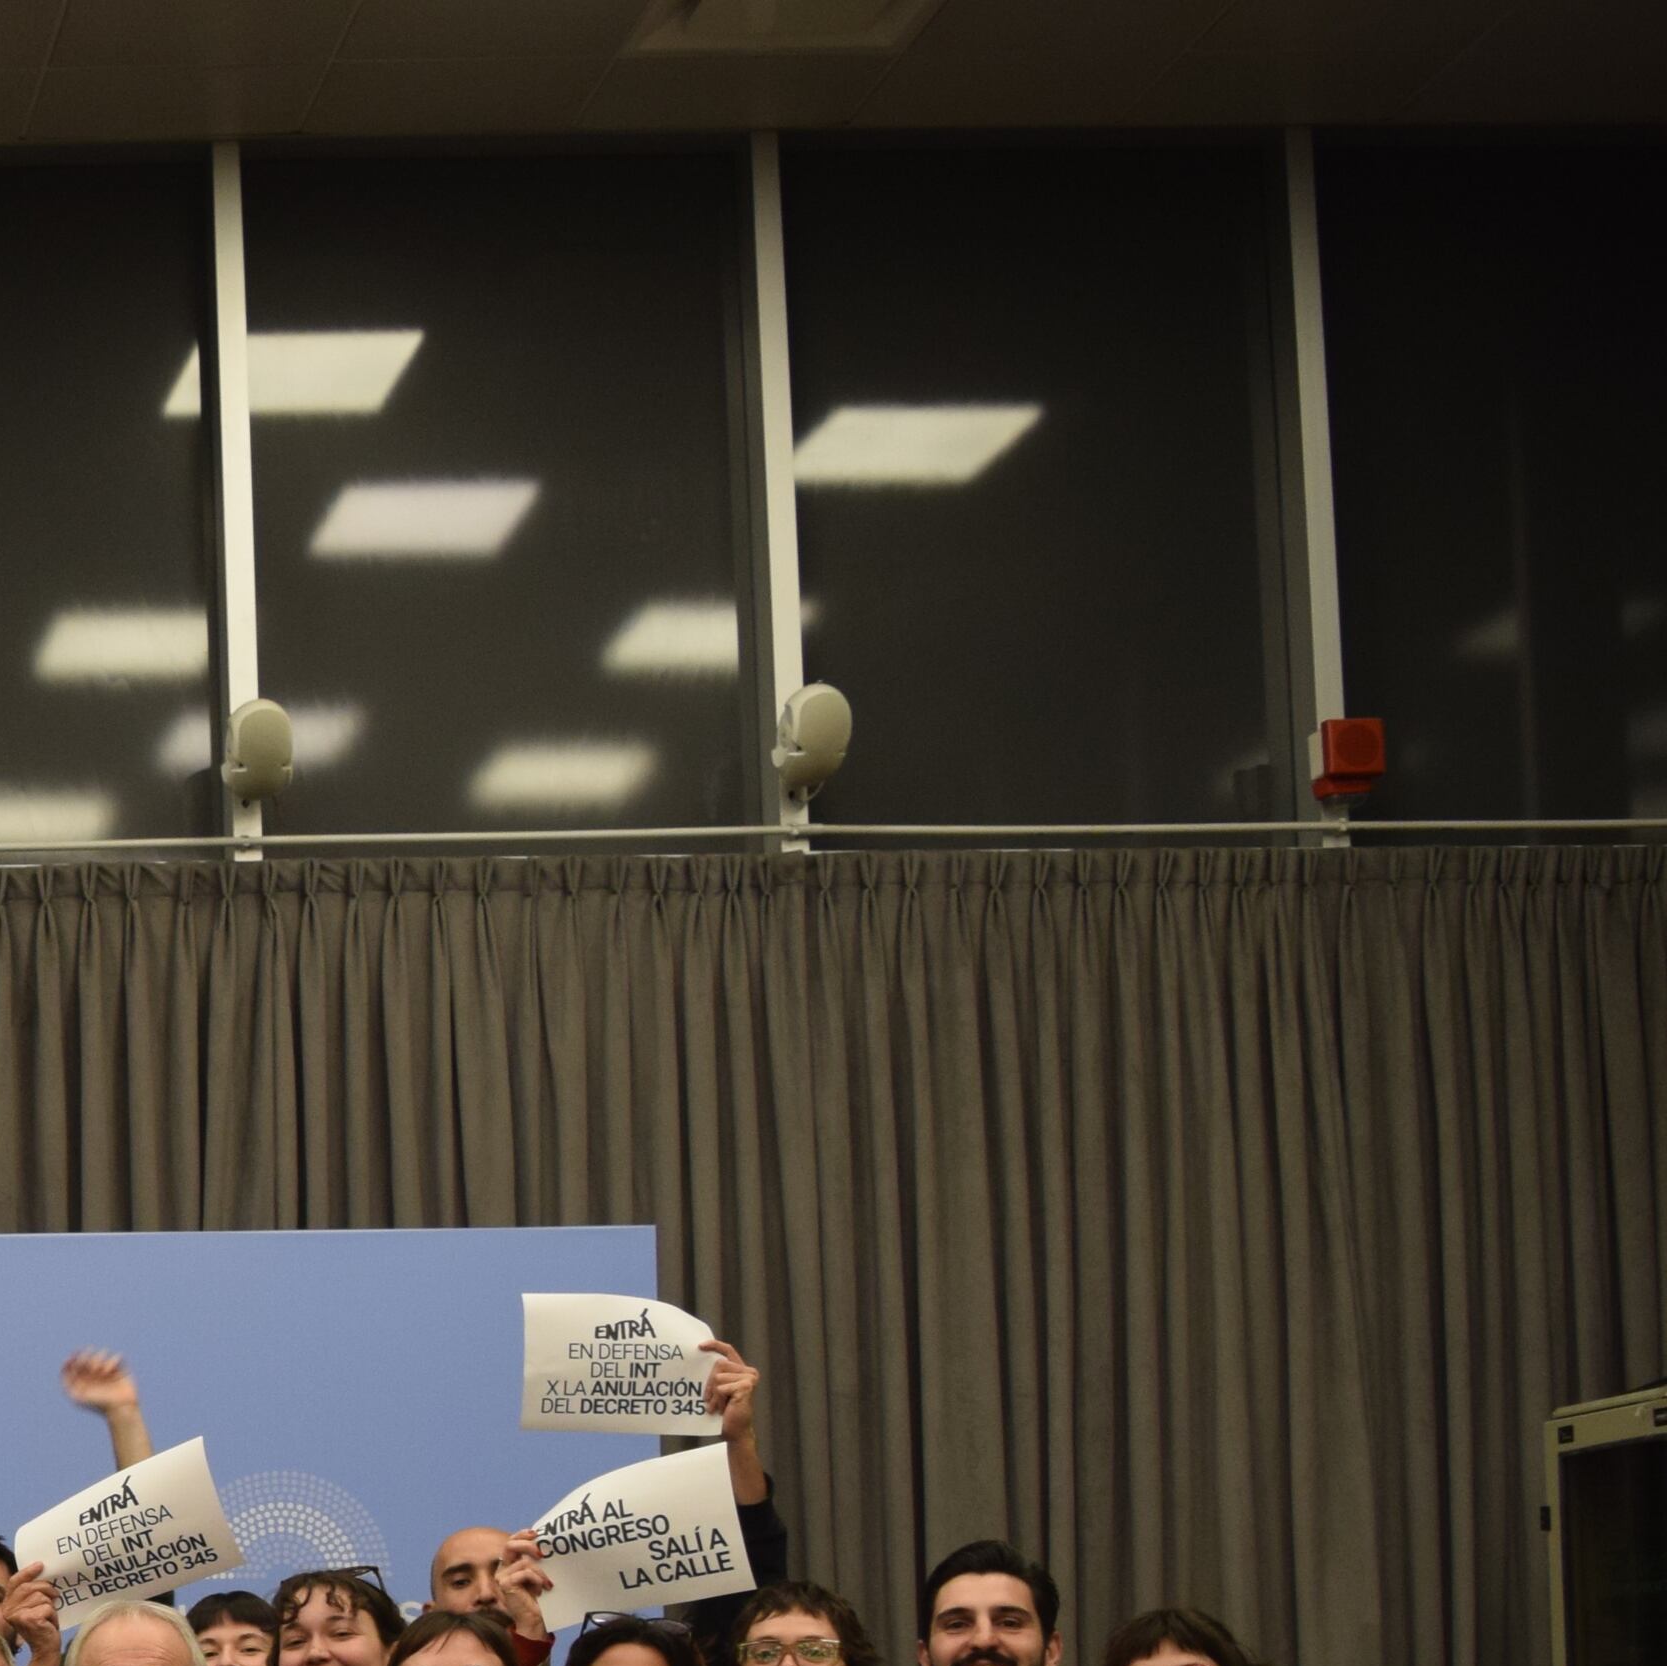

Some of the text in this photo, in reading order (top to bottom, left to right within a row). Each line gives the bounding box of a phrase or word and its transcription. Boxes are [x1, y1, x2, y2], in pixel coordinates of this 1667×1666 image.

[595, 1308, 656, 1341] ENTRÁ
[569, 1343, 685, 1360] EN DEFENSA
[591, 1362, 661, 1378] DEL INT
[547, 1377, 702, 1396] X LA ANULACIÓN
[541, 1398, 705, 1415] DEL DECRETO 345
